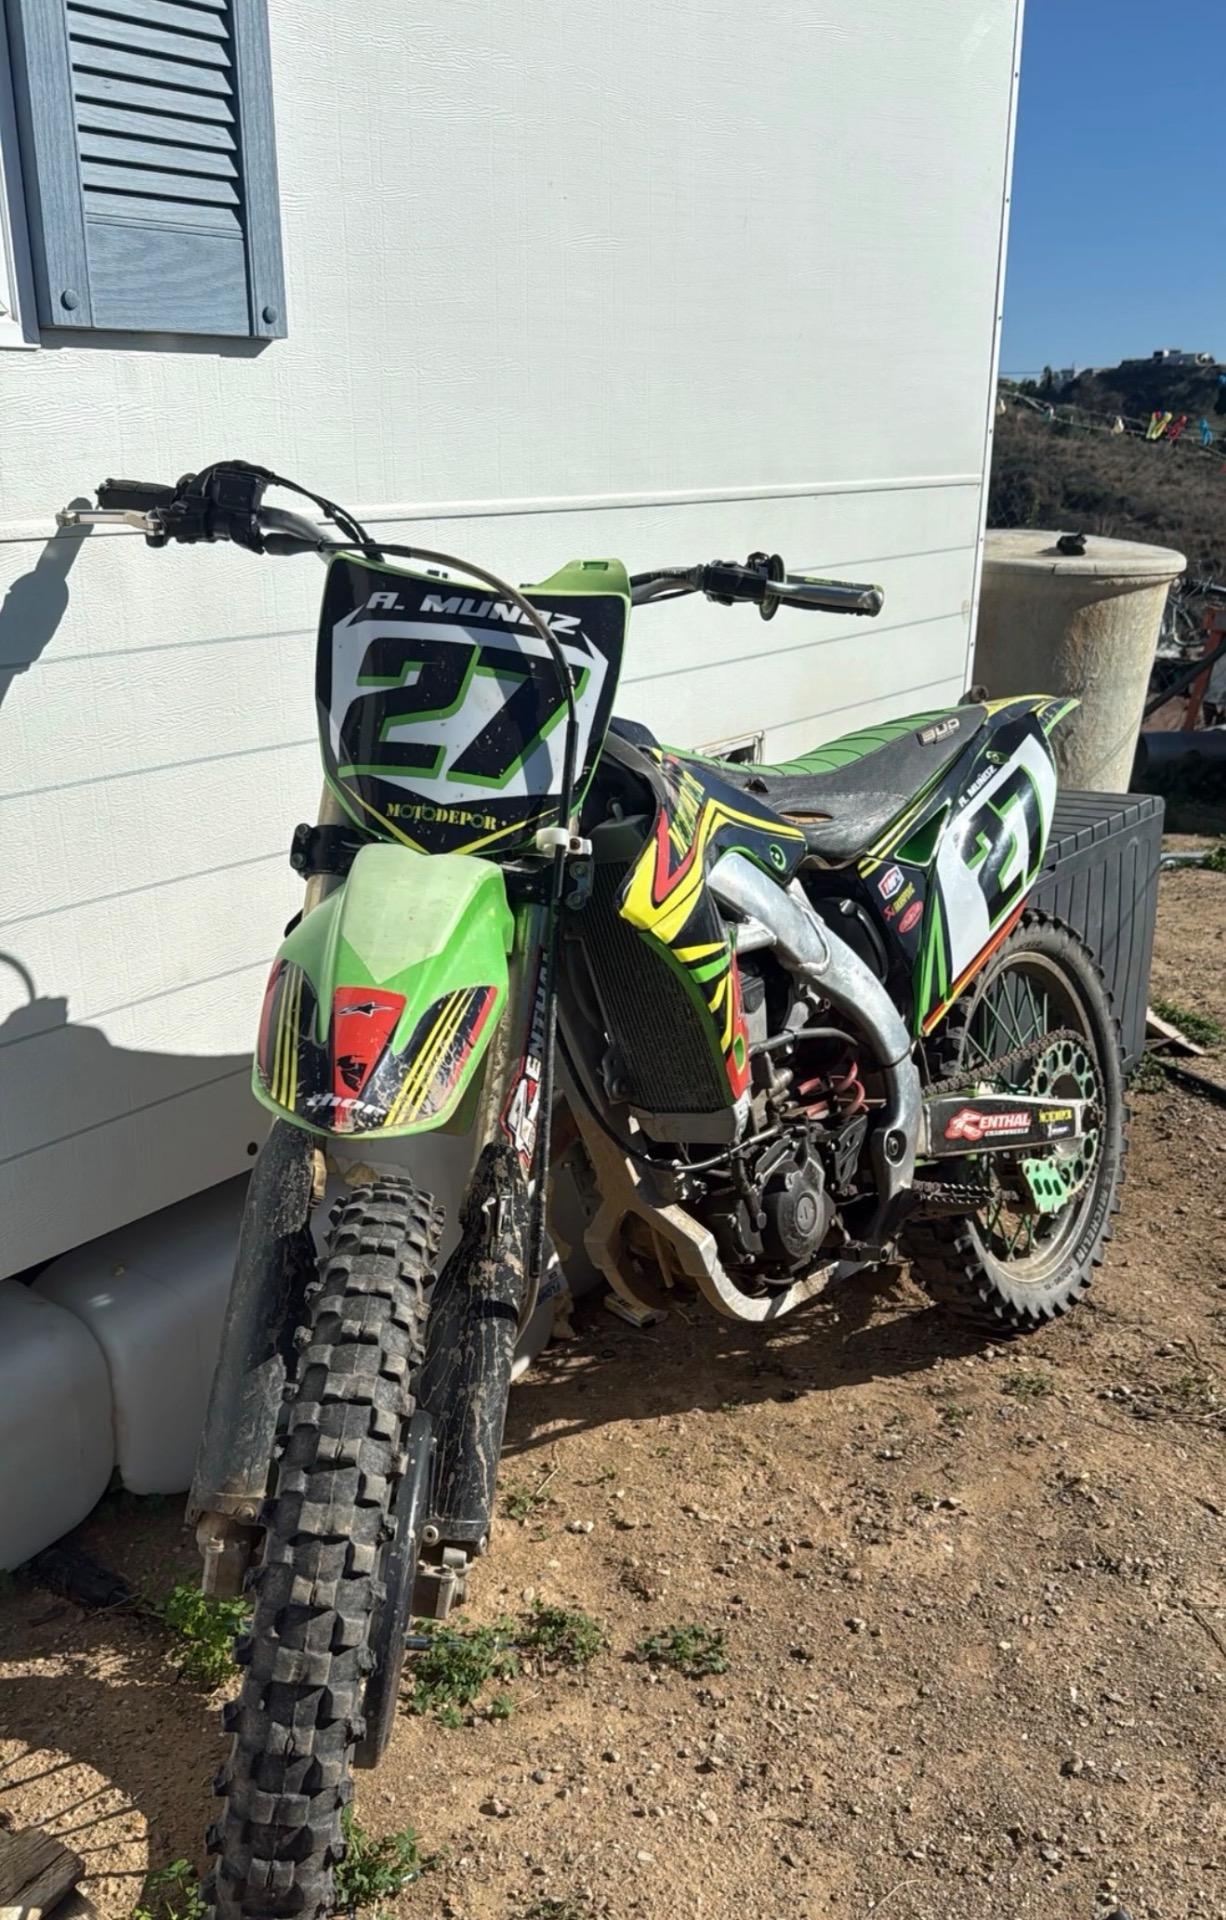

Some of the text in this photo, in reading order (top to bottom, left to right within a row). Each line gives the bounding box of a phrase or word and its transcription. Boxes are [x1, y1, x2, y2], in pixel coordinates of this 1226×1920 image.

[338, 637, 592, 790] 27
[945, 1109, 1032, 1140] RENTHAL
[1075, 1188, 1109, 1264] MICHELIN
